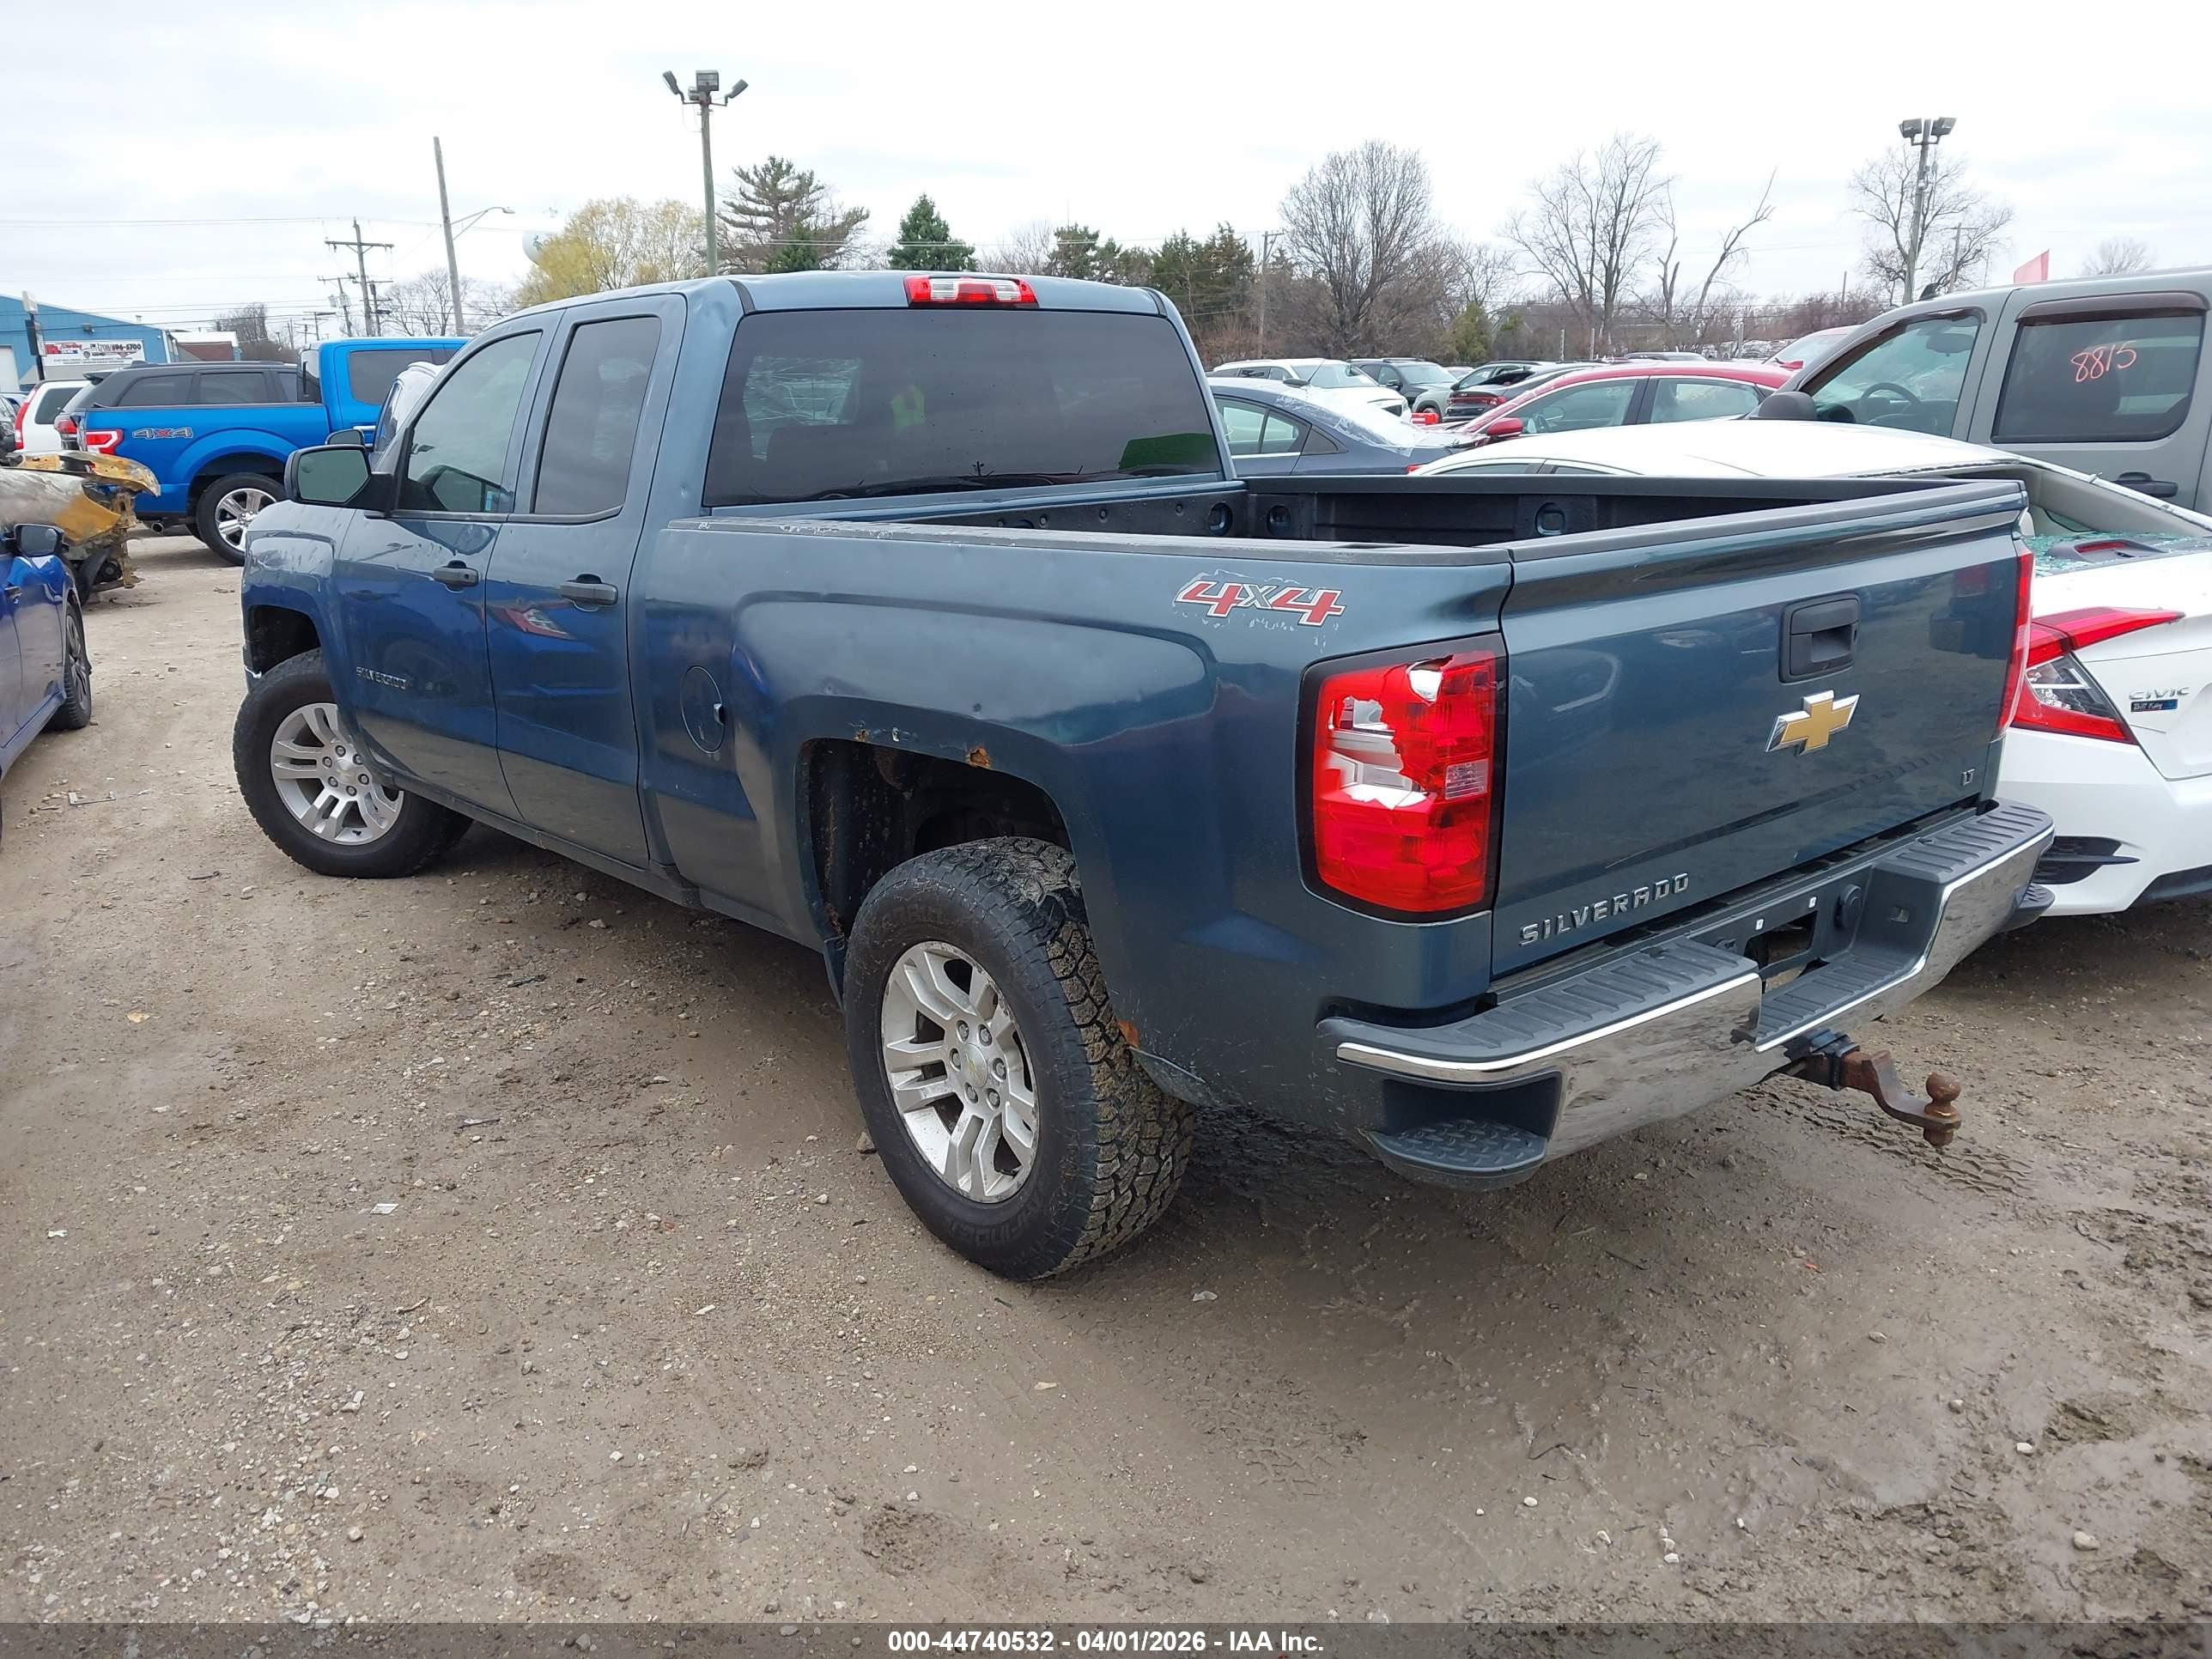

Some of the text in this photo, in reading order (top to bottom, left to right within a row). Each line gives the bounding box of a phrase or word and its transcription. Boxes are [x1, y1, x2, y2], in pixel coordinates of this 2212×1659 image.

[2069, 340, 2136, 383] 8815
[2129, 686, 2191, 701] CIVIC
[1518, 872, 1690, 947] SILVERADO
